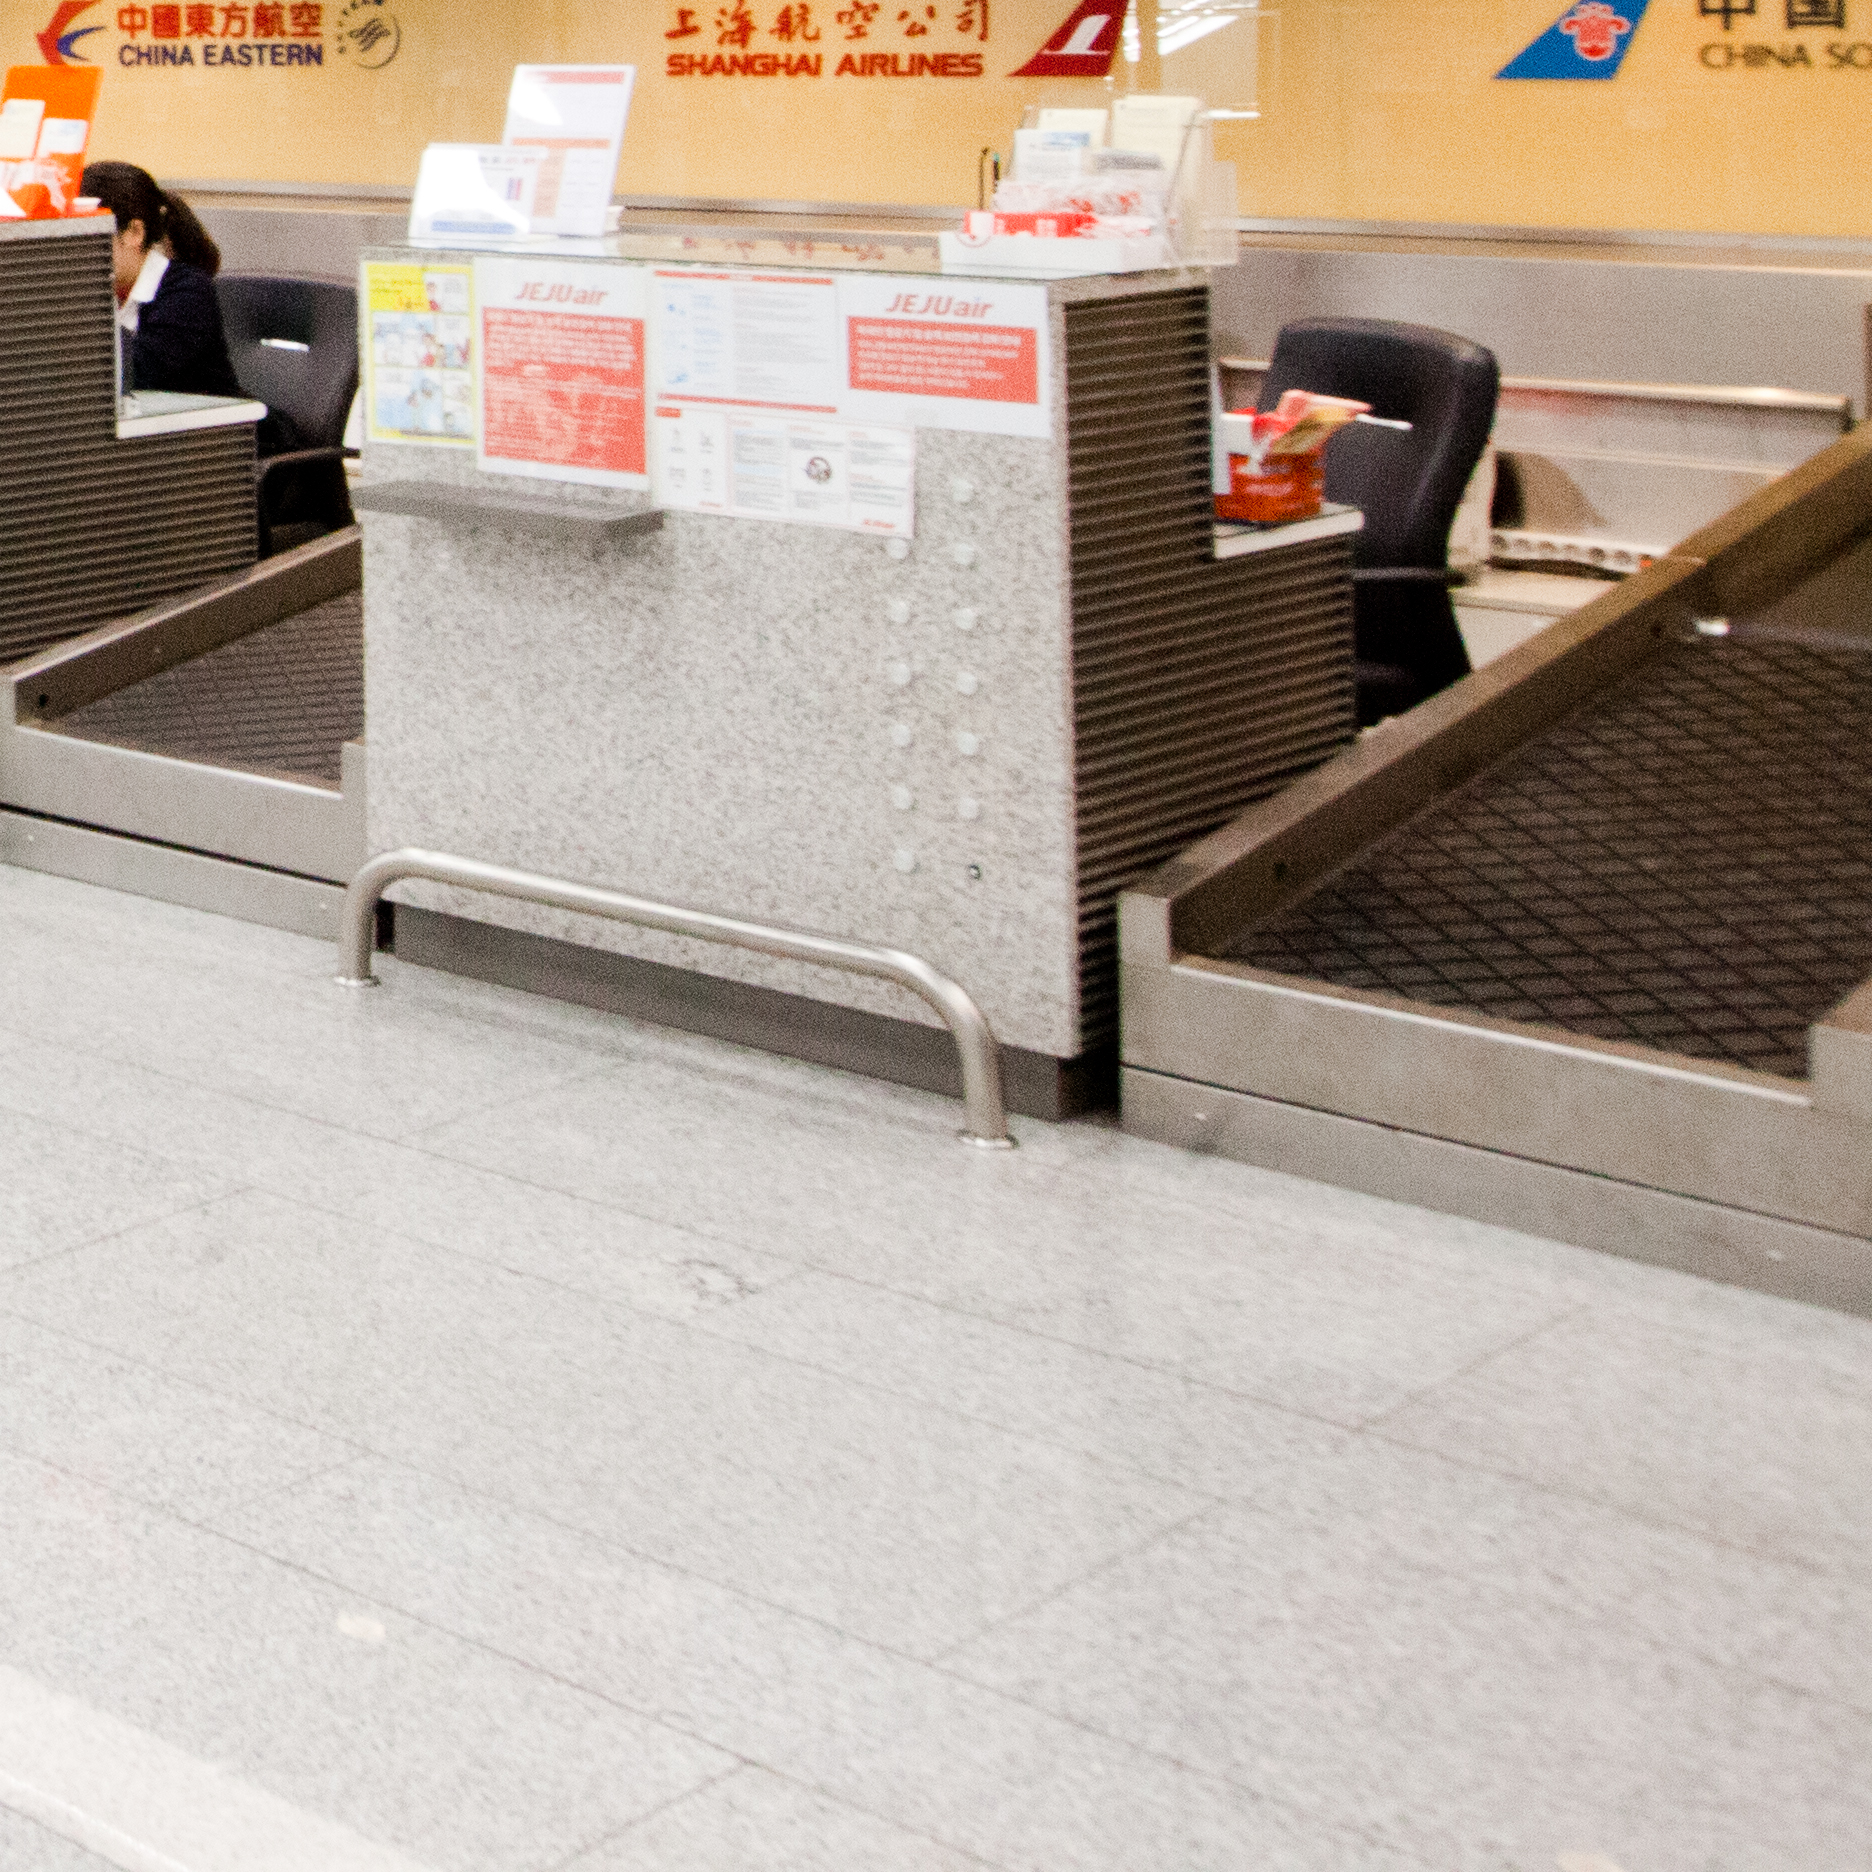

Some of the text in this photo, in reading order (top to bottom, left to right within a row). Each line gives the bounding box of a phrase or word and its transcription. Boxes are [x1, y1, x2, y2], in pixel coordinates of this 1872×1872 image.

[117, 1, 323, 40] 中國東方航空
[118, 42, 323, 67] CHINA EASTERN
[666, 53, 984, 77] SHANGHAI AIRLINES
[1698, 42, 1812, 69] CHINA
